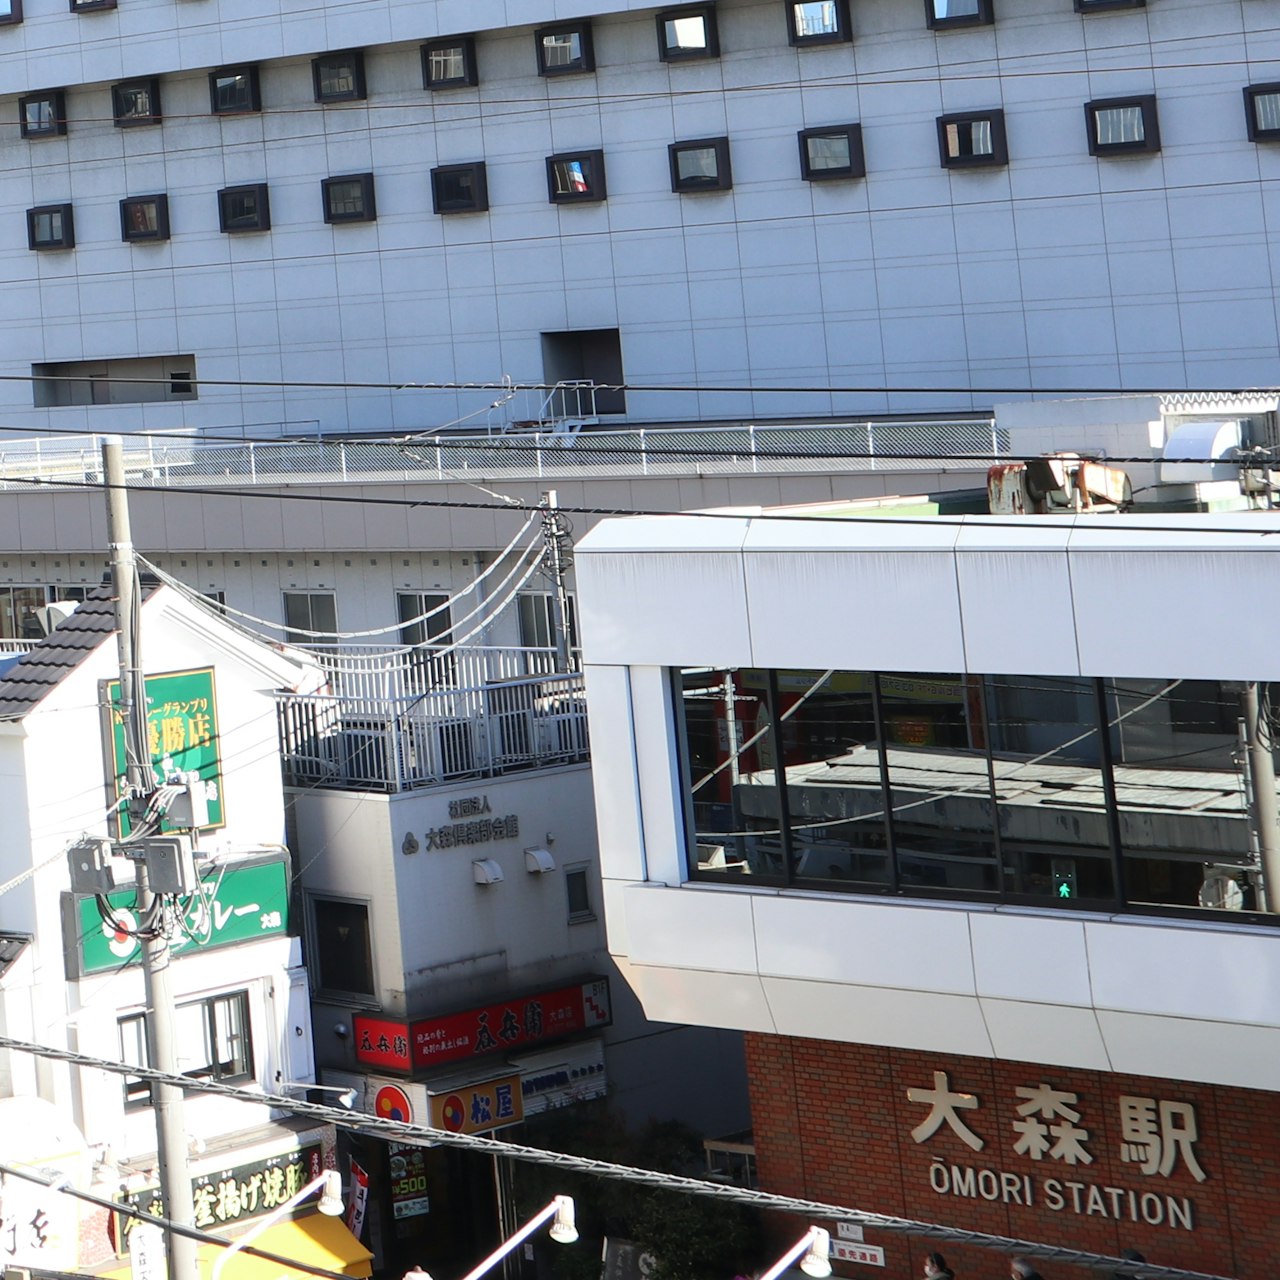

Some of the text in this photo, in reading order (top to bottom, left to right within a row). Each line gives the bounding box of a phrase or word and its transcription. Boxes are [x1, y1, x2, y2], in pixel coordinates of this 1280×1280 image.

[470, 1083, 515, 1125] 松屋
[906, 1070, 1207, 1183] 大森駅
[1043, 1179, 1194, 1231] STATION
